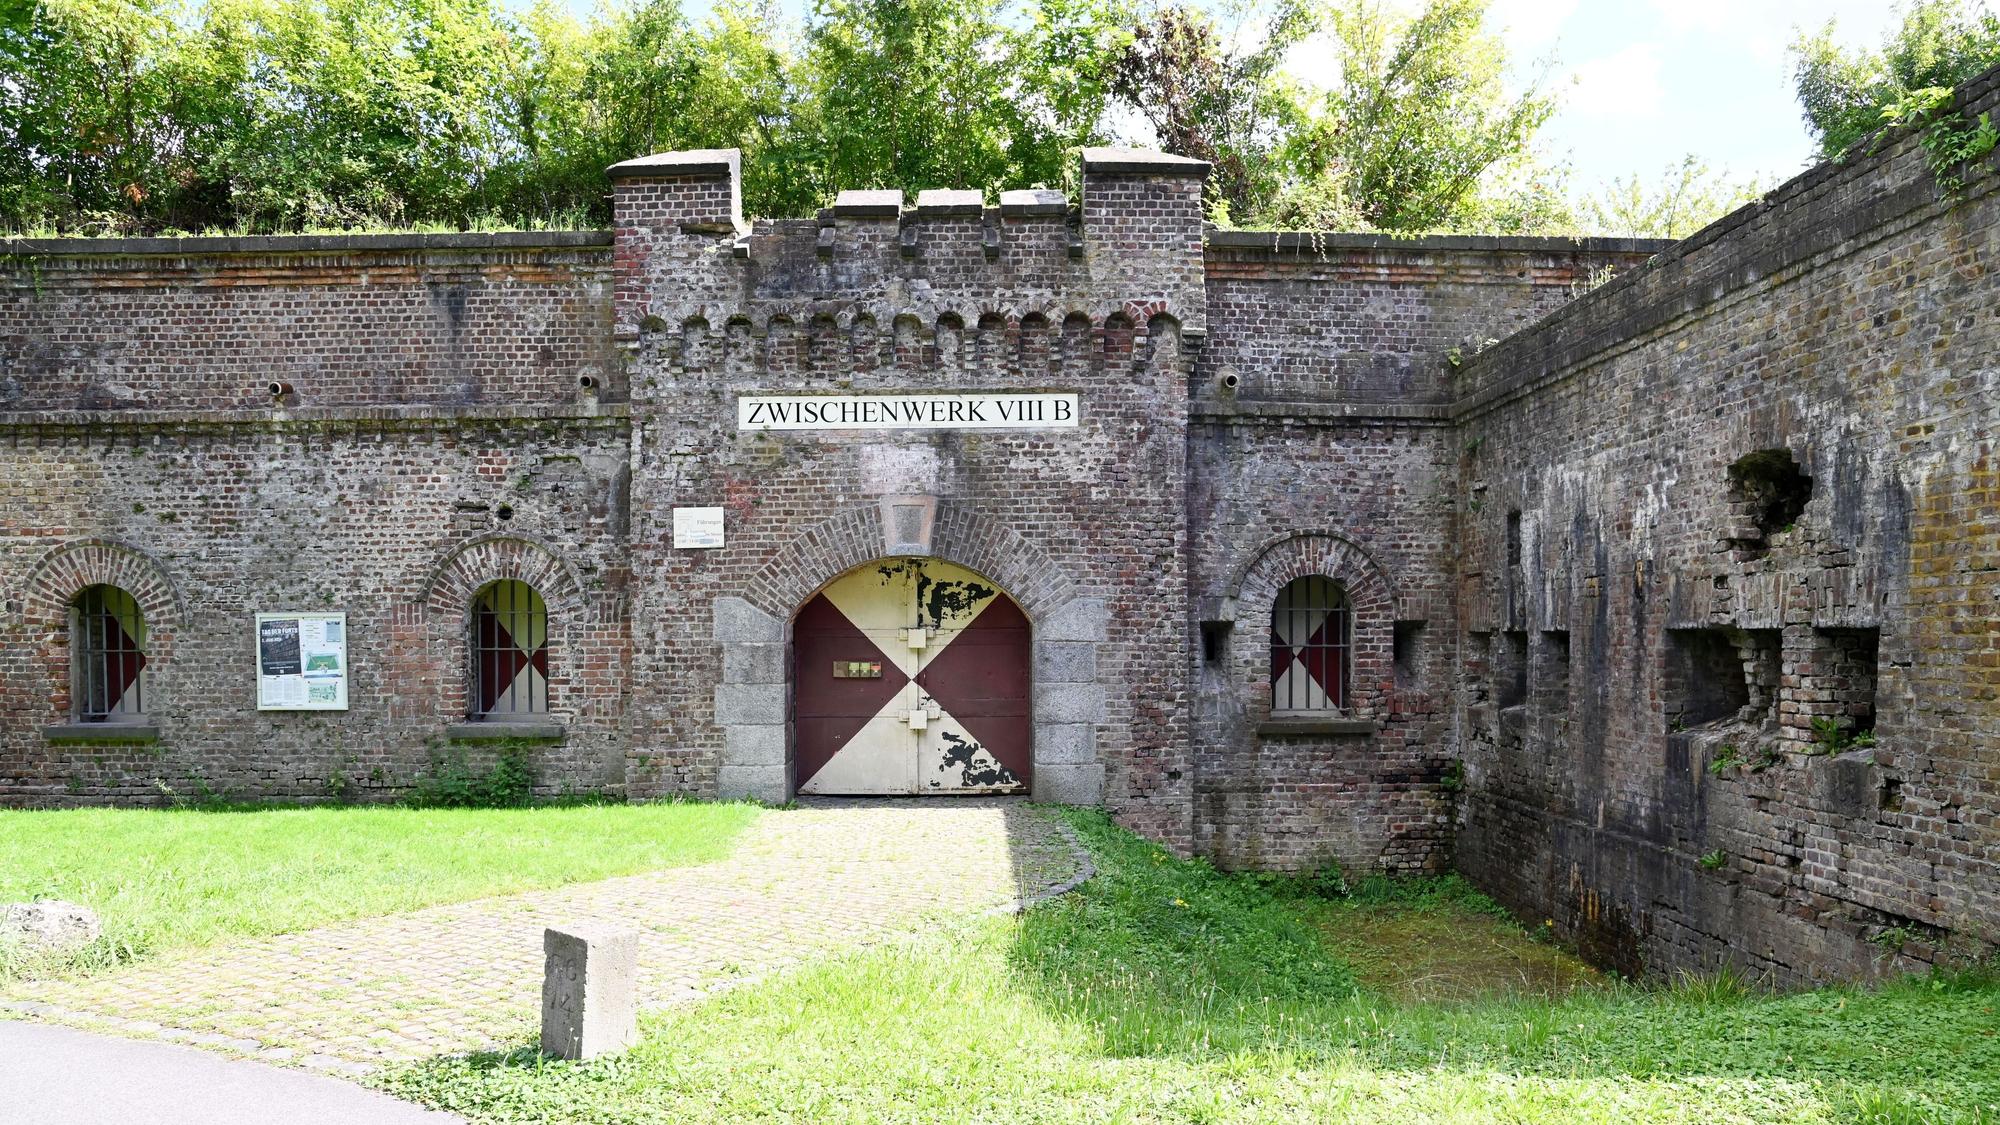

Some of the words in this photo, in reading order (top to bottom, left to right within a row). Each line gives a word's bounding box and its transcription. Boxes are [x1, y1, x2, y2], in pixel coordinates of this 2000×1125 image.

[747, 401, 987, 424] ZWISCHENWERK
[996, 400, 1043, 421] VIII
[1054, 399, 1072, 421] B
